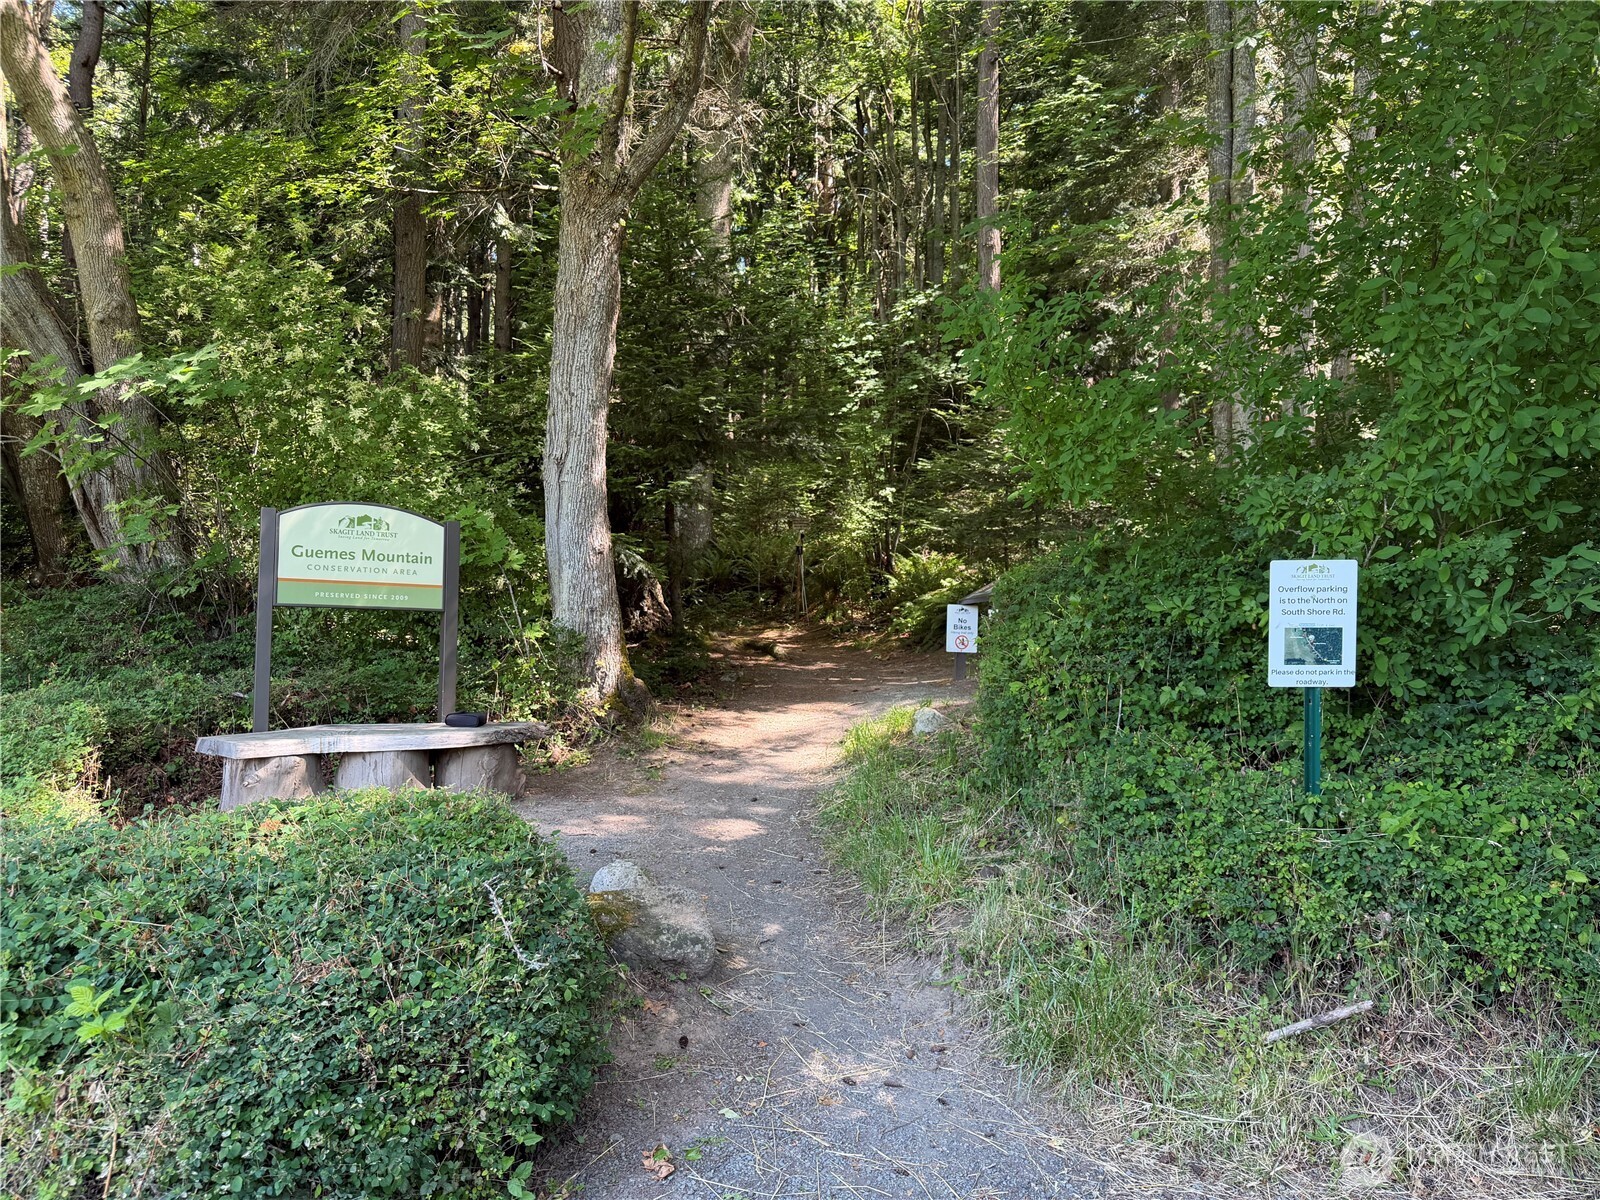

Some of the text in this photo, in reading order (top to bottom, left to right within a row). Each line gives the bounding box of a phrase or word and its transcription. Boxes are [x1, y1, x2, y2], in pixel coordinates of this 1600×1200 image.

[291, 544, 433, 564] Guemes Mountain
[306, 564, 418, 576] CONSERVATION AREA
[1277, 585, 1348, 595] Overflow parking
[1297, 596, 1311, 604] the
[1312, 596, 1336, 604] North
[1281, 608, 1346, 616] South Shore Rd.
[1318, 669, 1335, 678] park
[1295, 679, 1329, 687] roadway.
